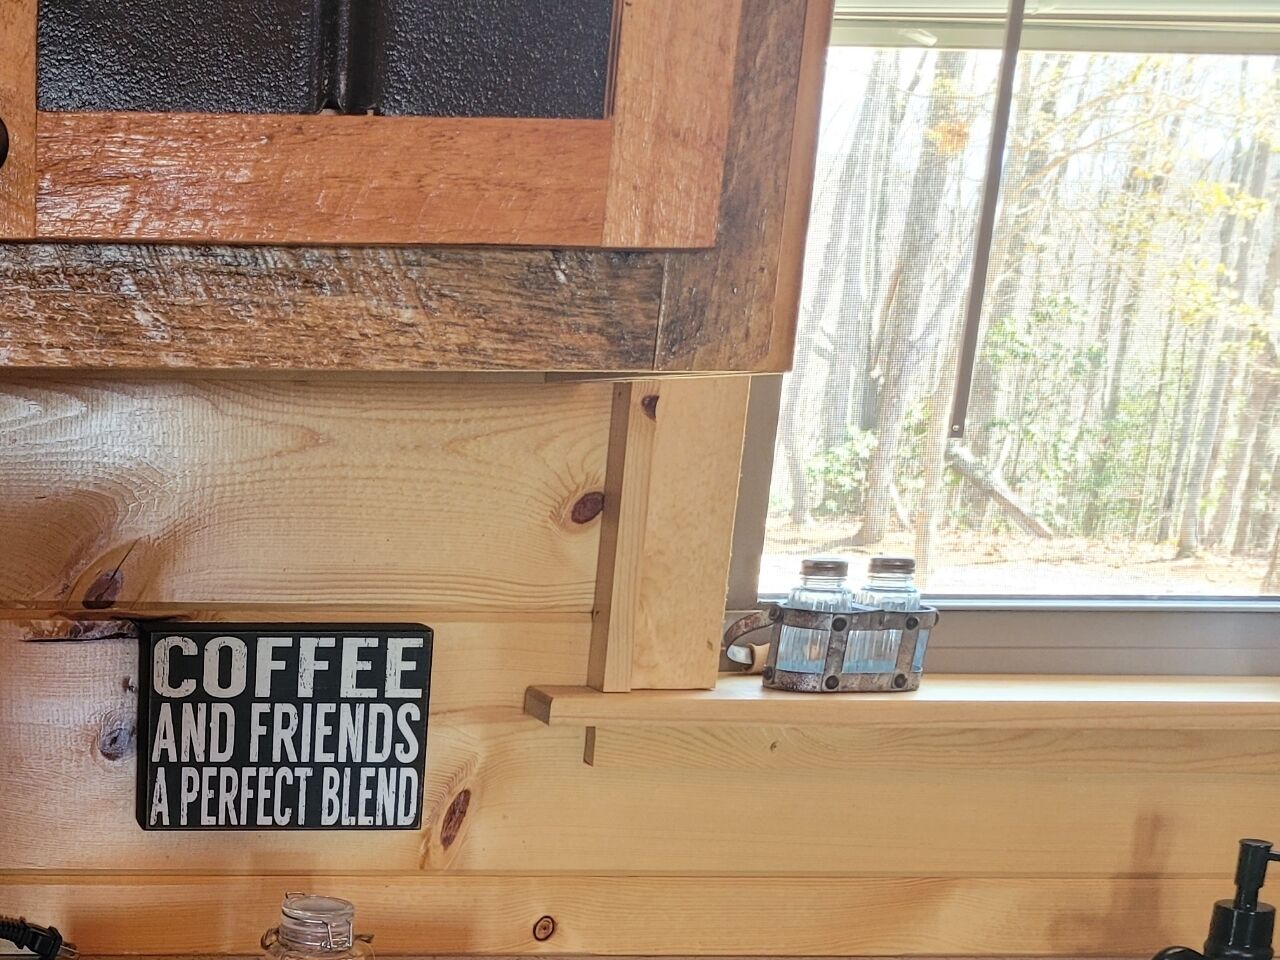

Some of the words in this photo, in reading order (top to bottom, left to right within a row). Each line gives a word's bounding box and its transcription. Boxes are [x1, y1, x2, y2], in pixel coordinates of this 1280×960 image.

[153, 635, 424, 698] COFFEE
[151, 702, 236, 763] AND
[249, 702, 421, 763] FRIENDS
[149, 766, 170, 826] A
[180, 766, 313, 826] PERFECT
[320, 766, 419, 827] BLEND
